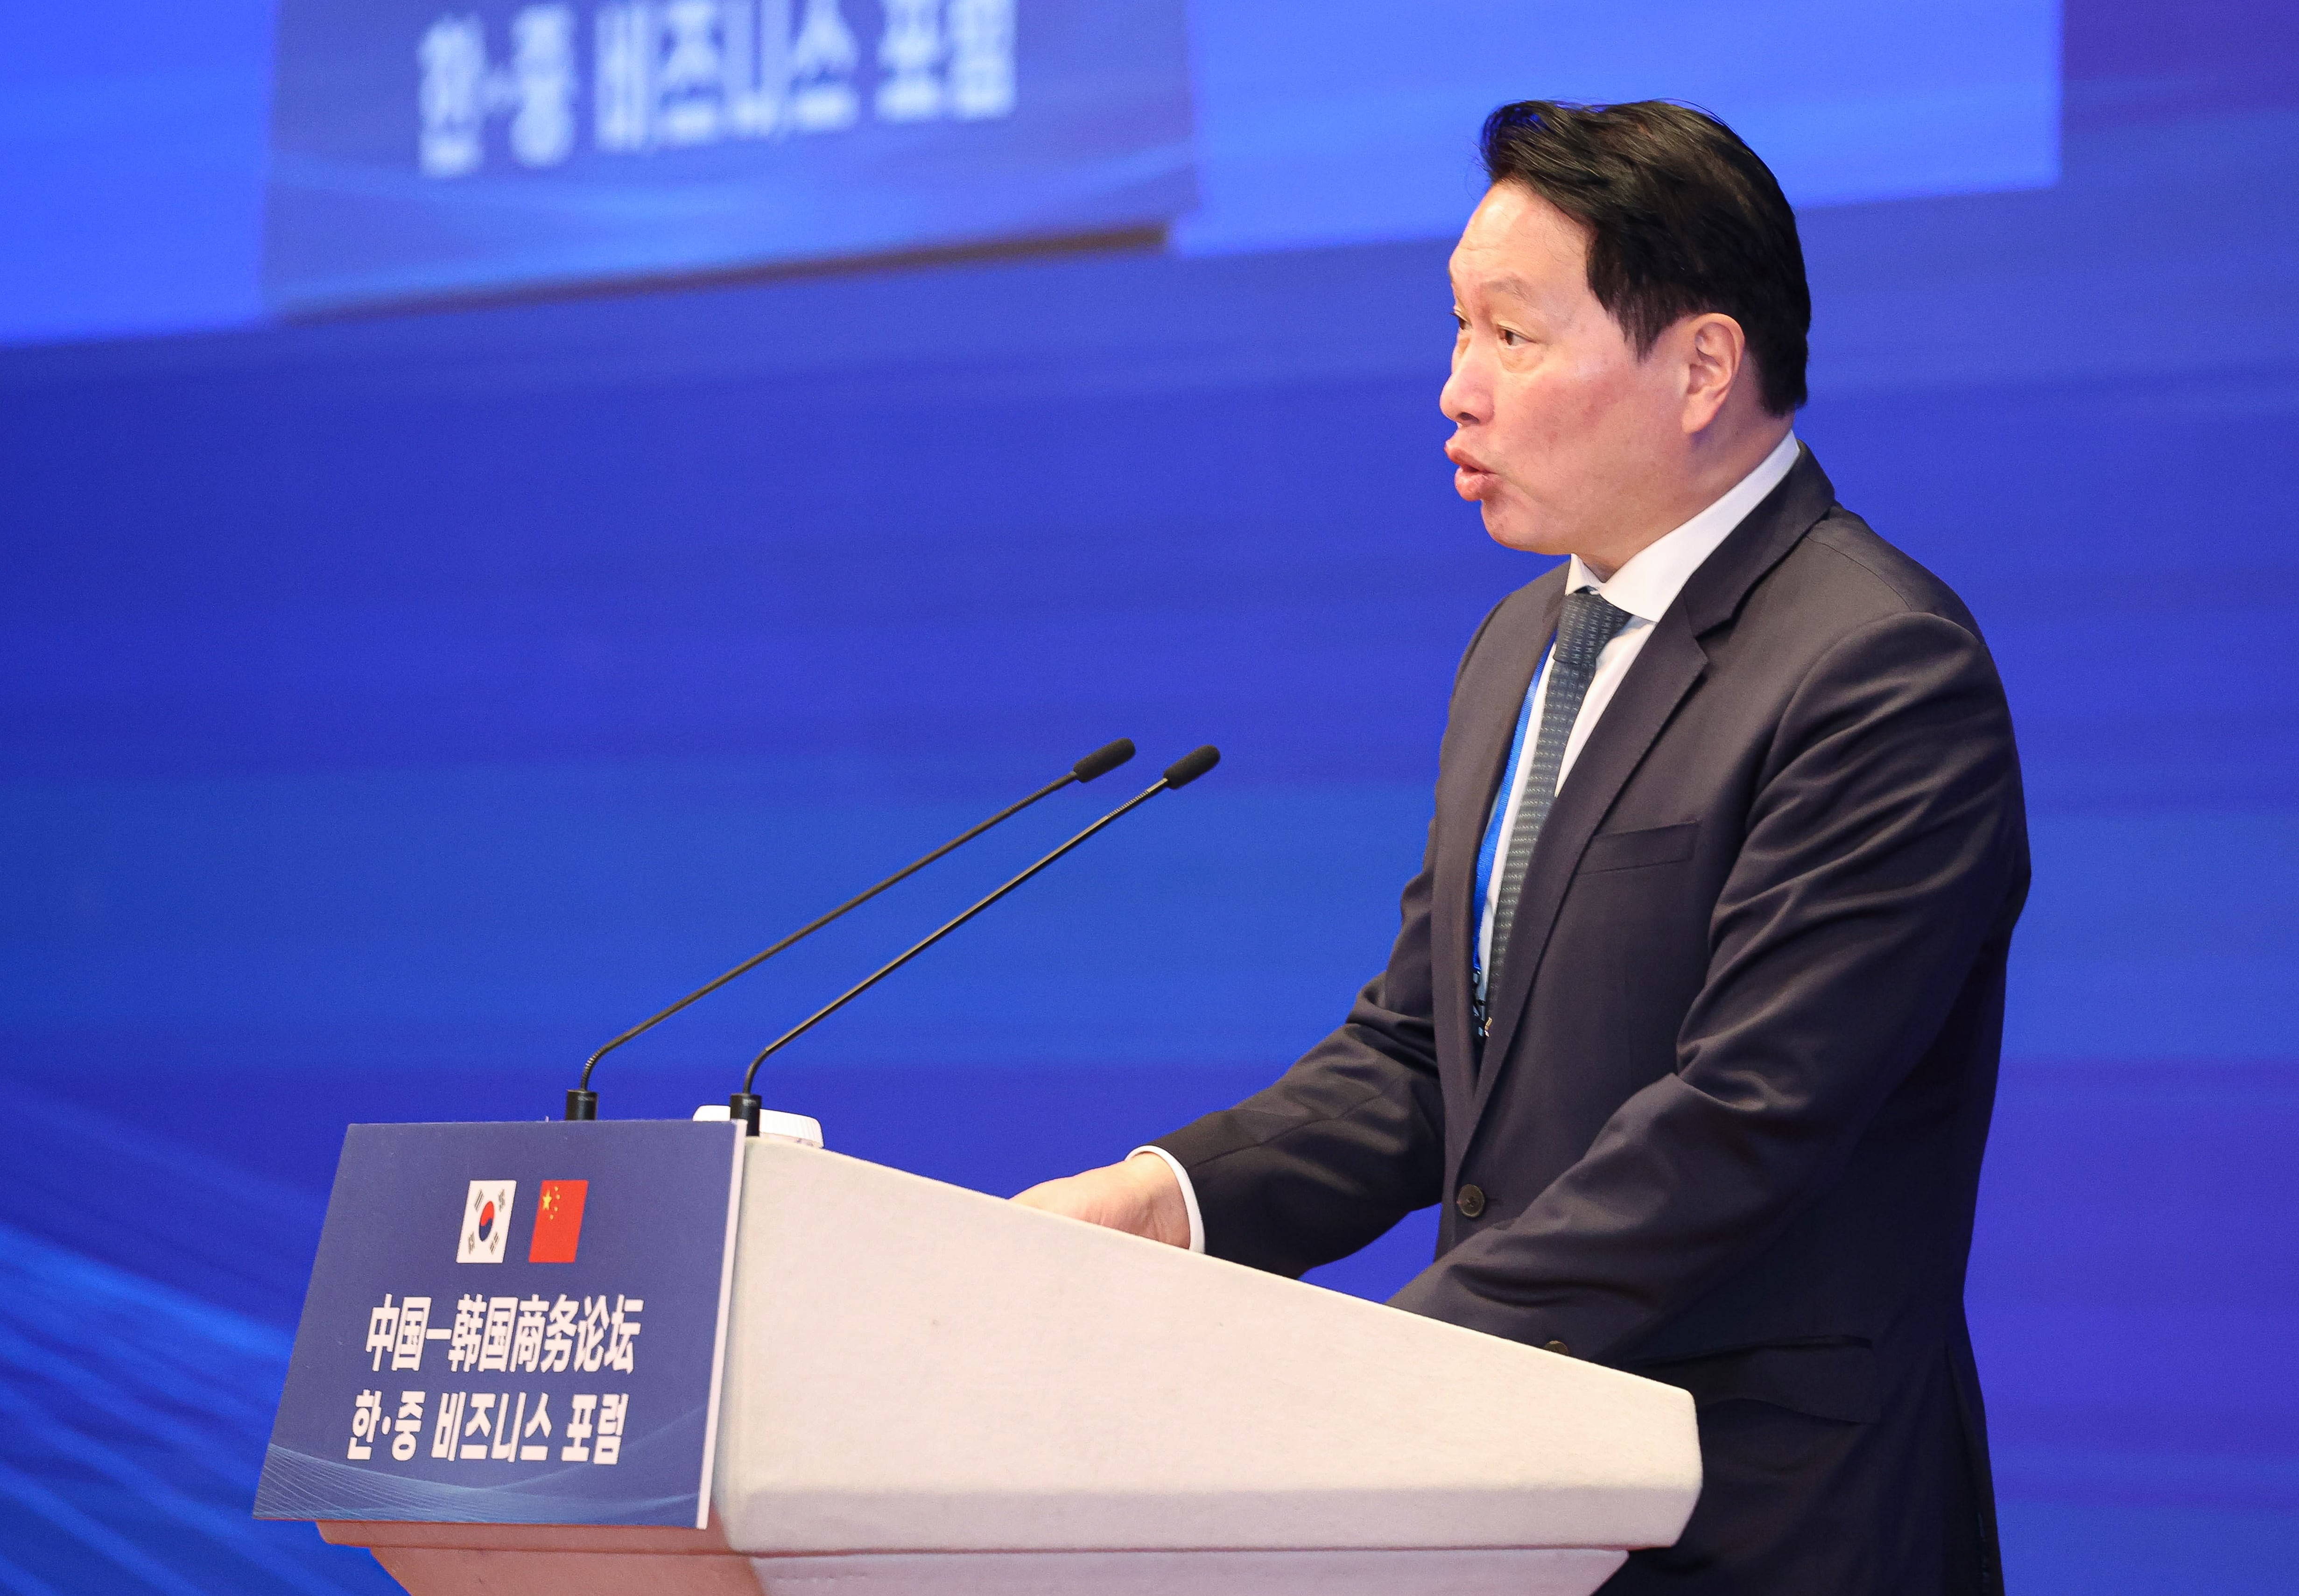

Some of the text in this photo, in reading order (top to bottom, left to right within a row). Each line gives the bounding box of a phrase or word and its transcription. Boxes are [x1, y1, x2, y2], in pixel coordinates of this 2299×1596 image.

[347, 1389, 630, 1465] 한·중 비즈니스 포럼
